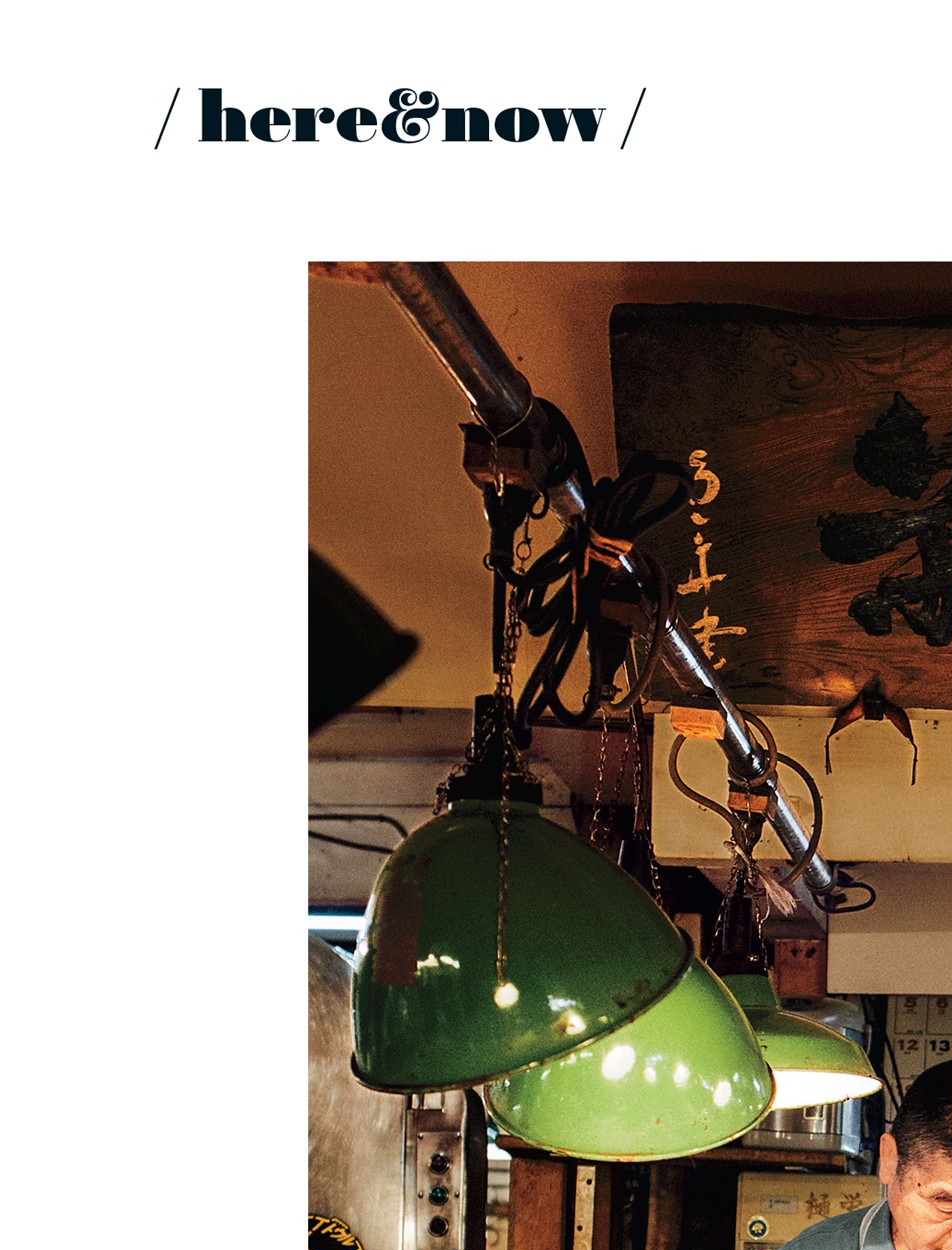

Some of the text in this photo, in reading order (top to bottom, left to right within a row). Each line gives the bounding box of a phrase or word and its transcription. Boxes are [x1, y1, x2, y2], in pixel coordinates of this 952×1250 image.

[904, 997, 917, 1008] 5
[936, 997, 948, 1009] 6
[897, 1039, 920, 1052] 12
[929, 1040, 951, 1053] 13
